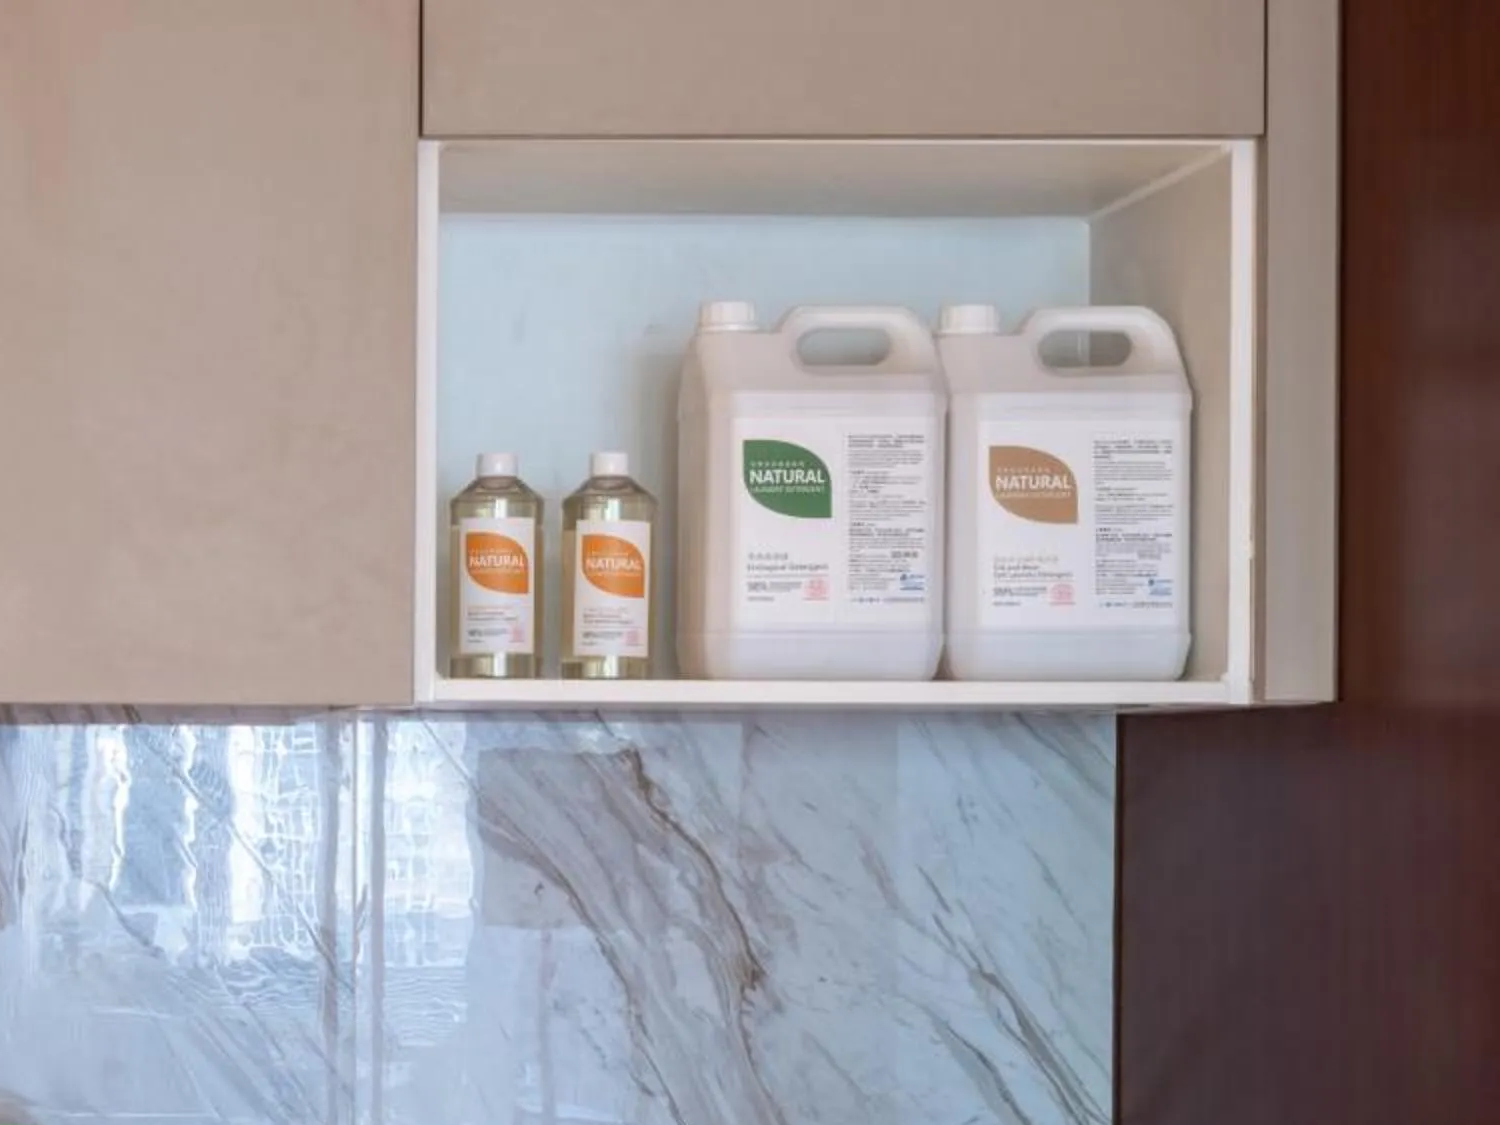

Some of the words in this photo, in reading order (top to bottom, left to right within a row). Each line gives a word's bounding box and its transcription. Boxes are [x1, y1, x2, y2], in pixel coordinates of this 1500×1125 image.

[750, 468, 826, 484] NATURAL
[995, 474, 1072, 489] NATURAL
[468, 554, 525, 568] NATURAL
[586, 557, 643, 571] NATURAL
